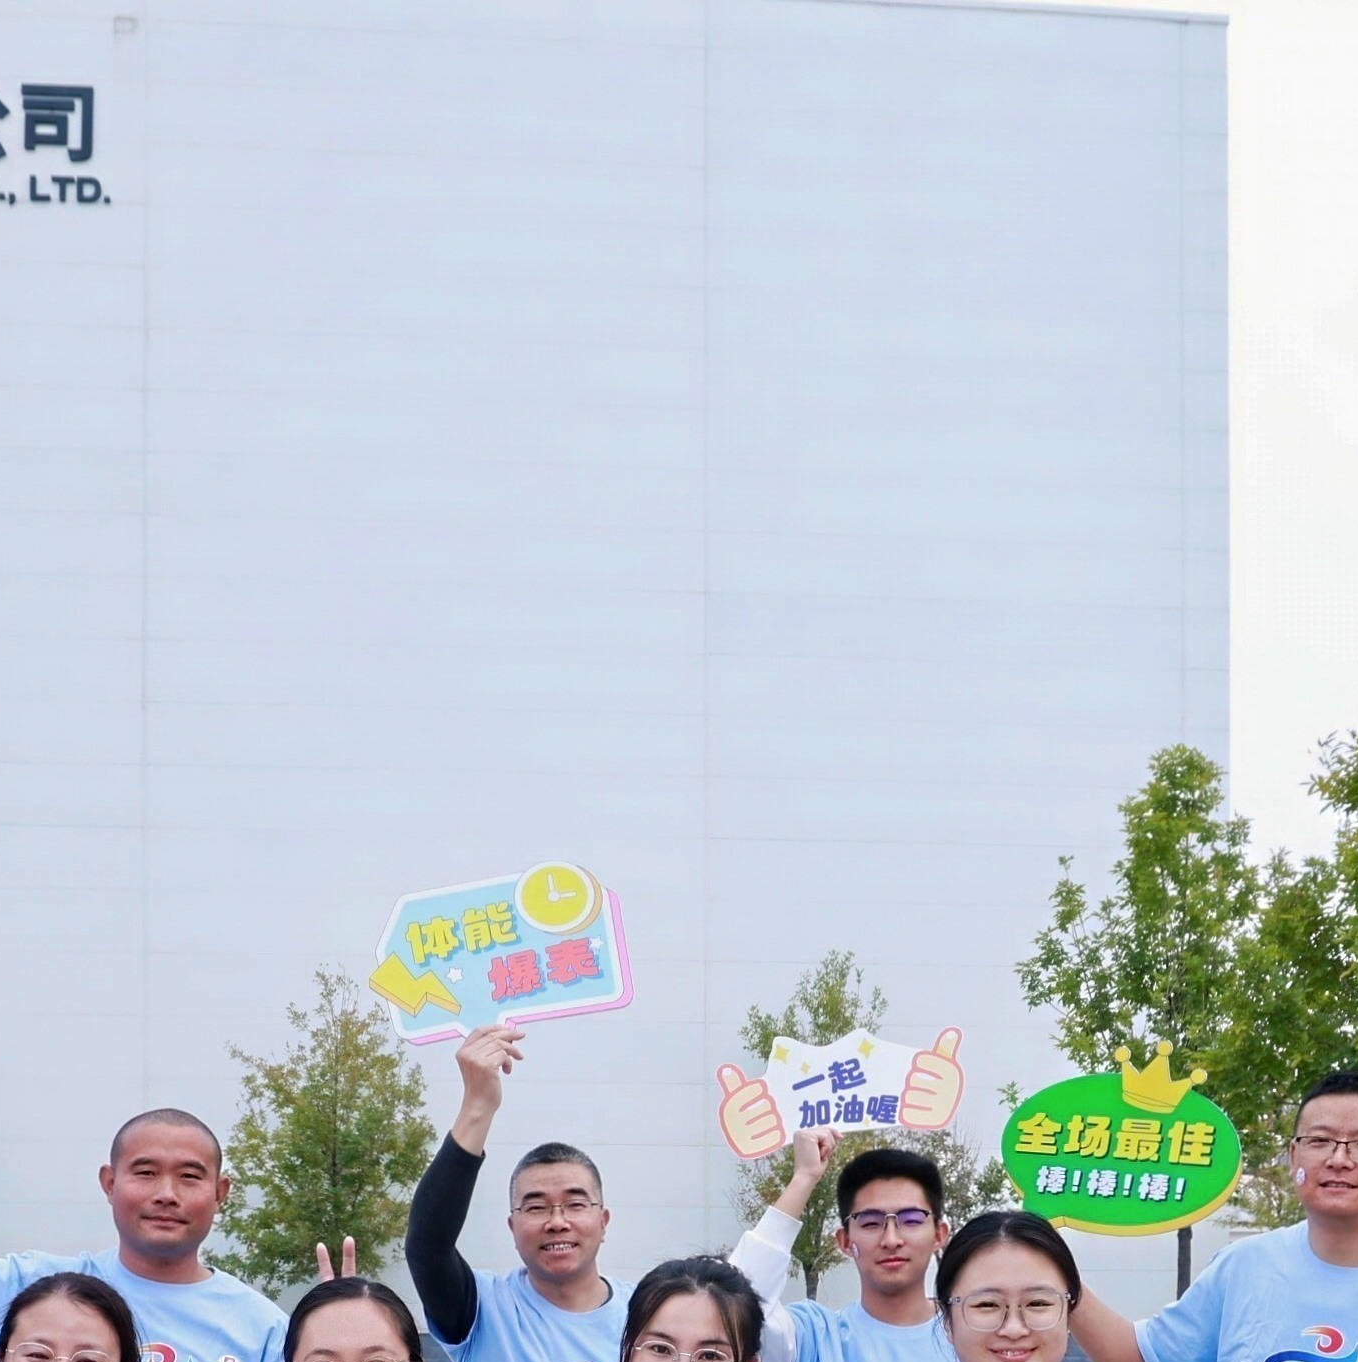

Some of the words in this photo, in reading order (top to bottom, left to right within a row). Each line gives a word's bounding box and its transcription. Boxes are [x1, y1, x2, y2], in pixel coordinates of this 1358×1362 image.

[29, 175, 112, 204] LTD.
[405, 900, 518, 965] 体能
[488, 937, 600, 1001] 爆表
[792, 1058, 867, 1094] 一起
[798, 1094, 900, 1129] 加油喔
[1015, 1112, 1216, 1166] 全场最佳
